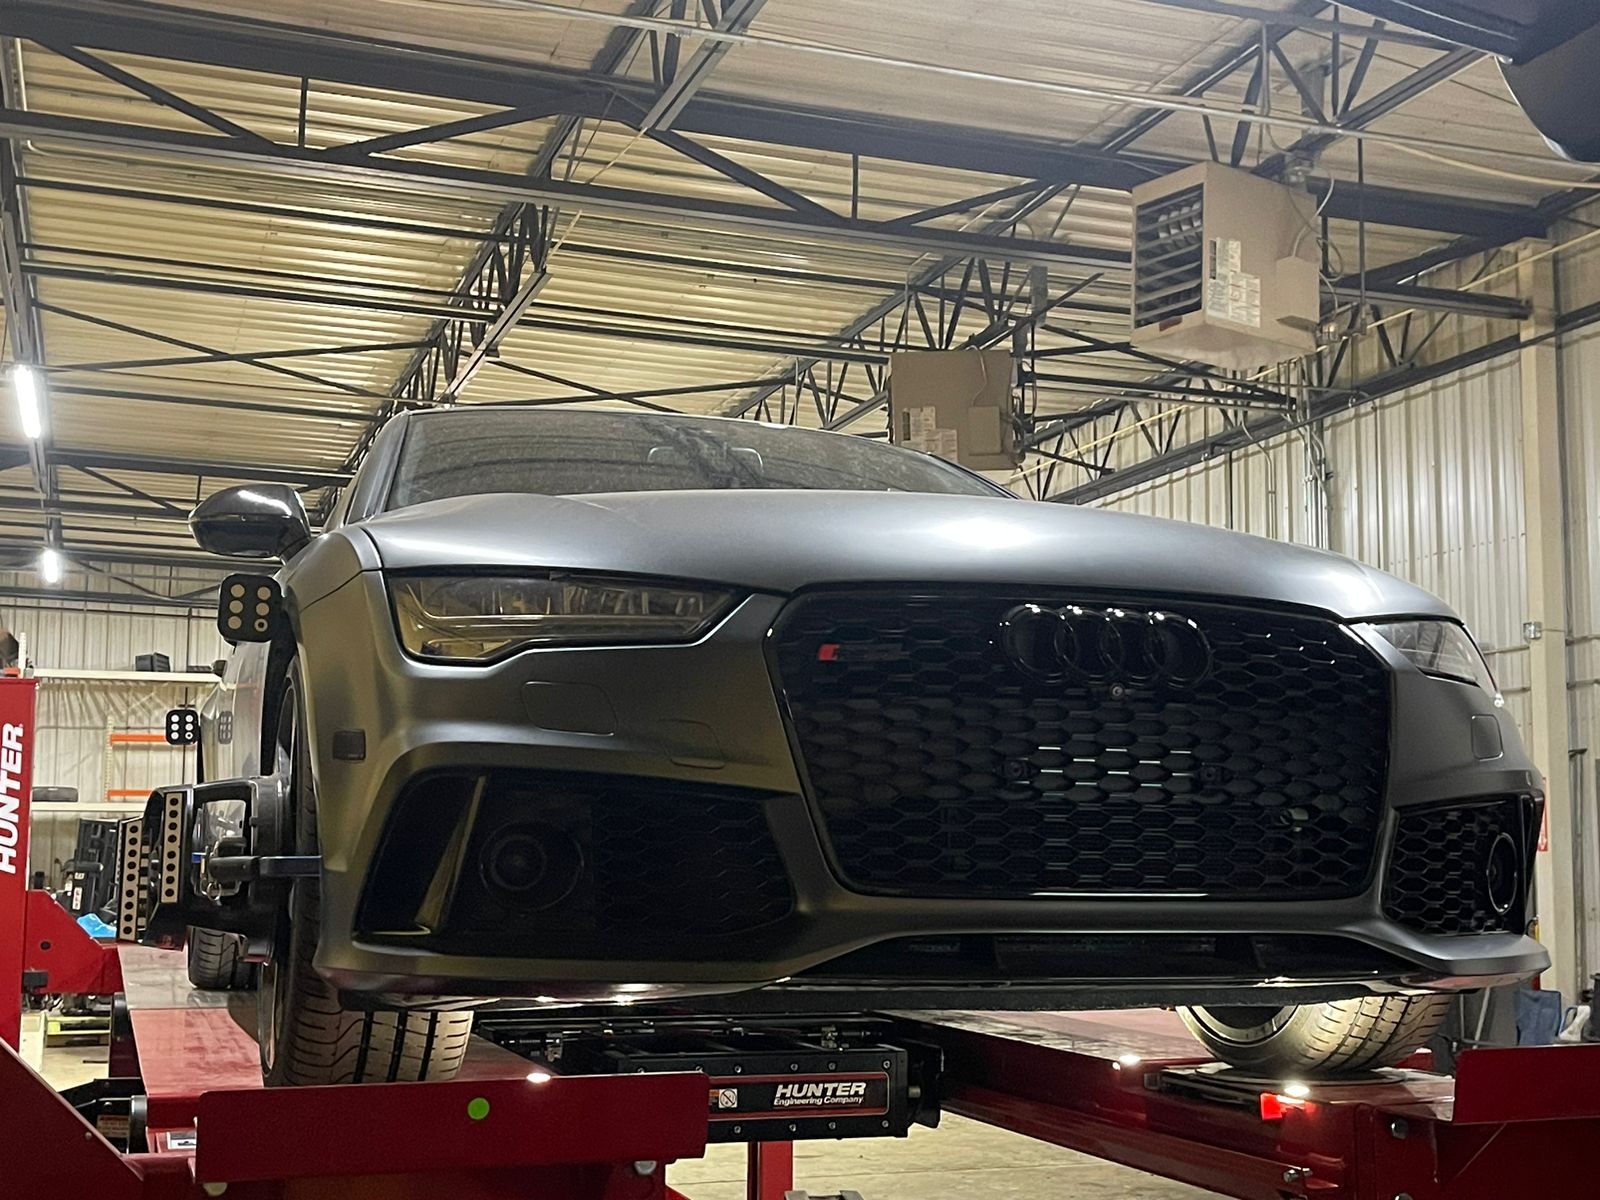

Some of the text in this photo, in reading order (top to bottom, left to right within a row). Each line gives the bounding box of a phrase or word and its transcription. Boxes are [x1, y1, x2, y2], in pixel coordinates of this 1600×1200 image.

[0, 723, 23, 874] HUNTER
[775, 1082, 867, 1098] HUNTER
[773, 1096, 864, 1107] Engineering Company
